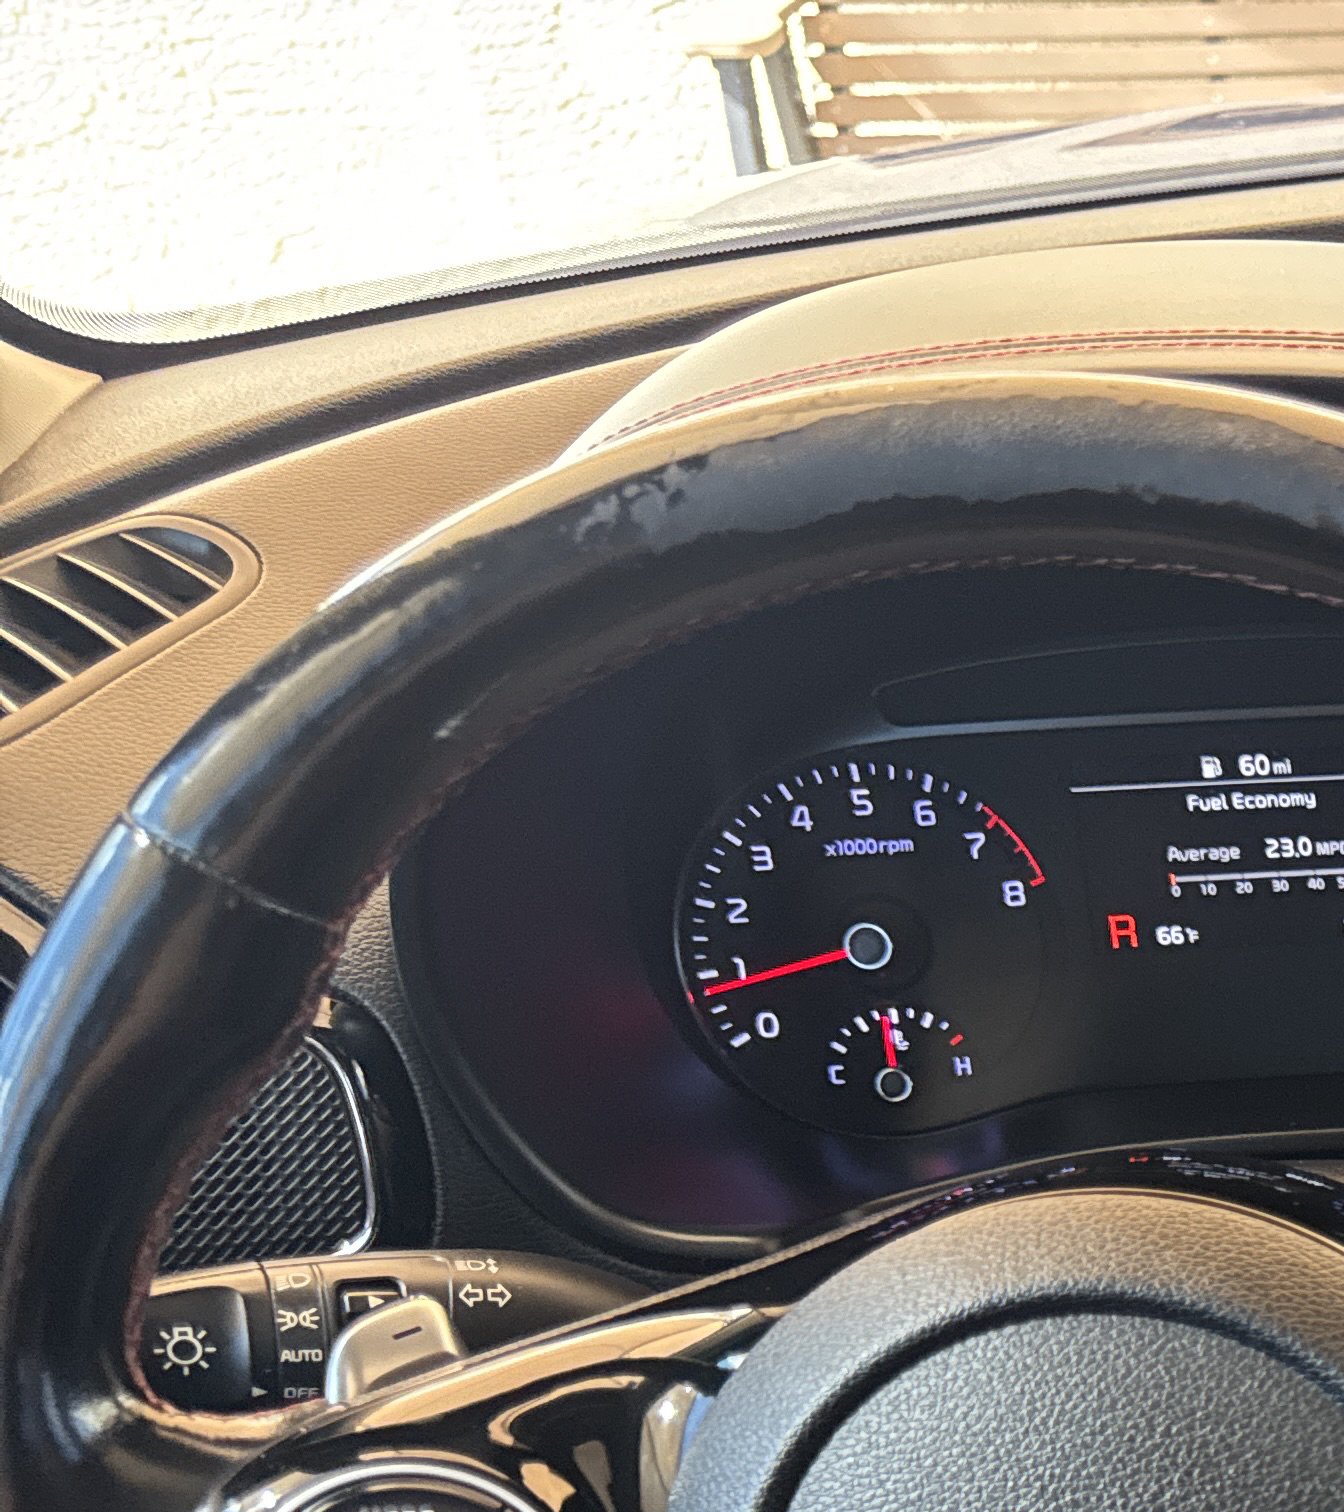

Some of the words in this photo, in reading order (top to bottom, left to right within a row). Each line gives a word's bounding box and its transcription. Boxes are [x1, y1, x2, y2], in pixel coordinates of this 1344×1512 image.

[849, 788, 874, 816] 5
[913, 800, 937, 827] 6
[1186, 793, 1227, 812] Fuel
[1232, 791, 1317, 810] Economy
[790, 805, 814, 831] 4
[963, 831, 987, 860] 7
[1167, 845, 1241, 863] Average
[1264, 836, 1312, 859] 23.0
[749, 845, 774, 872] 3
[1002, 880, 1027, 907] 8
[1171, 885, 1181, 898] 0
[1200, 883, 1217, 896] 10
[1235, 881, 1253, 894] 20
[1272, 879, 1290, 893] 30
[1307, 877, 1325, 891] 40
[726, 898, 750, 924] 2
[1107, 913, 1138, 949] R
[731, 956, 748, 980] 1
[755, 1012, 780, 1038] 0
[827, 1064, 846, 1085] C
[952, 1055, 973, 1076] H
[280, 1348, 323, 1363] AUTO
[284, 1387, 320, 1399] OFF
